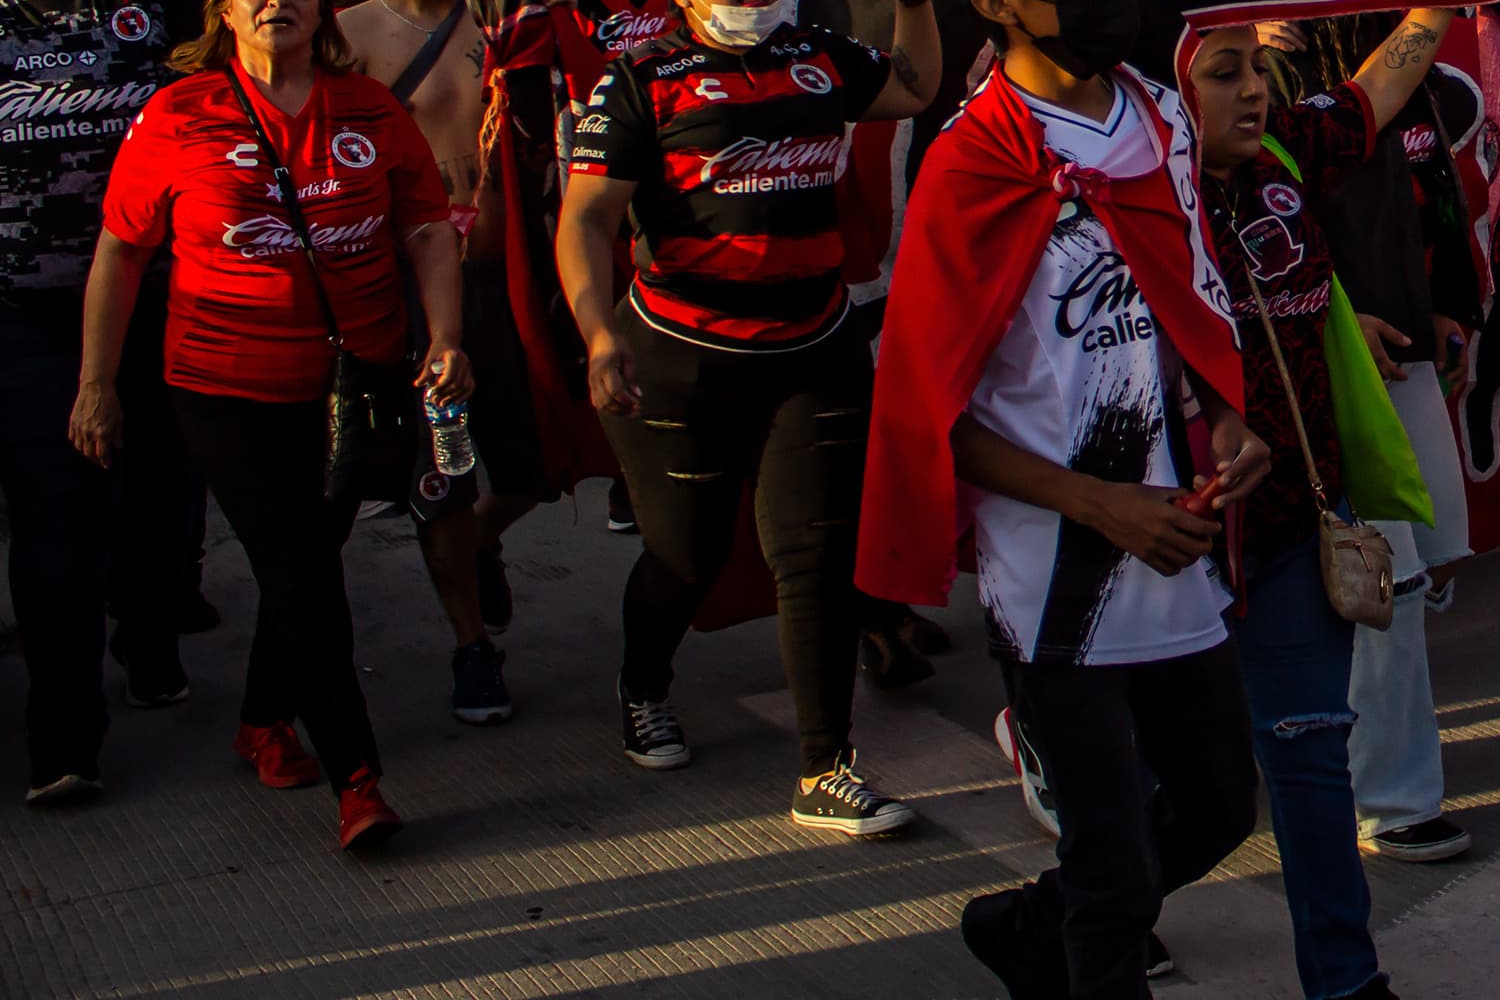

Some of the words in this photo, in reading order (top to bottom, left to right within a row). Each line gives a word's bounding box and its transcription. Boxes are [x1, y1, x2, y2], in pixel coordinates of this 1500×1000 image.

[14, 52, 73, 72] ARCO
[655, 58, 694, 78] ARCO
[698, 136, 841, 183] Calient
[321, 178, 341, 195] Jr.
[222, 214, 385, 248] Caente
